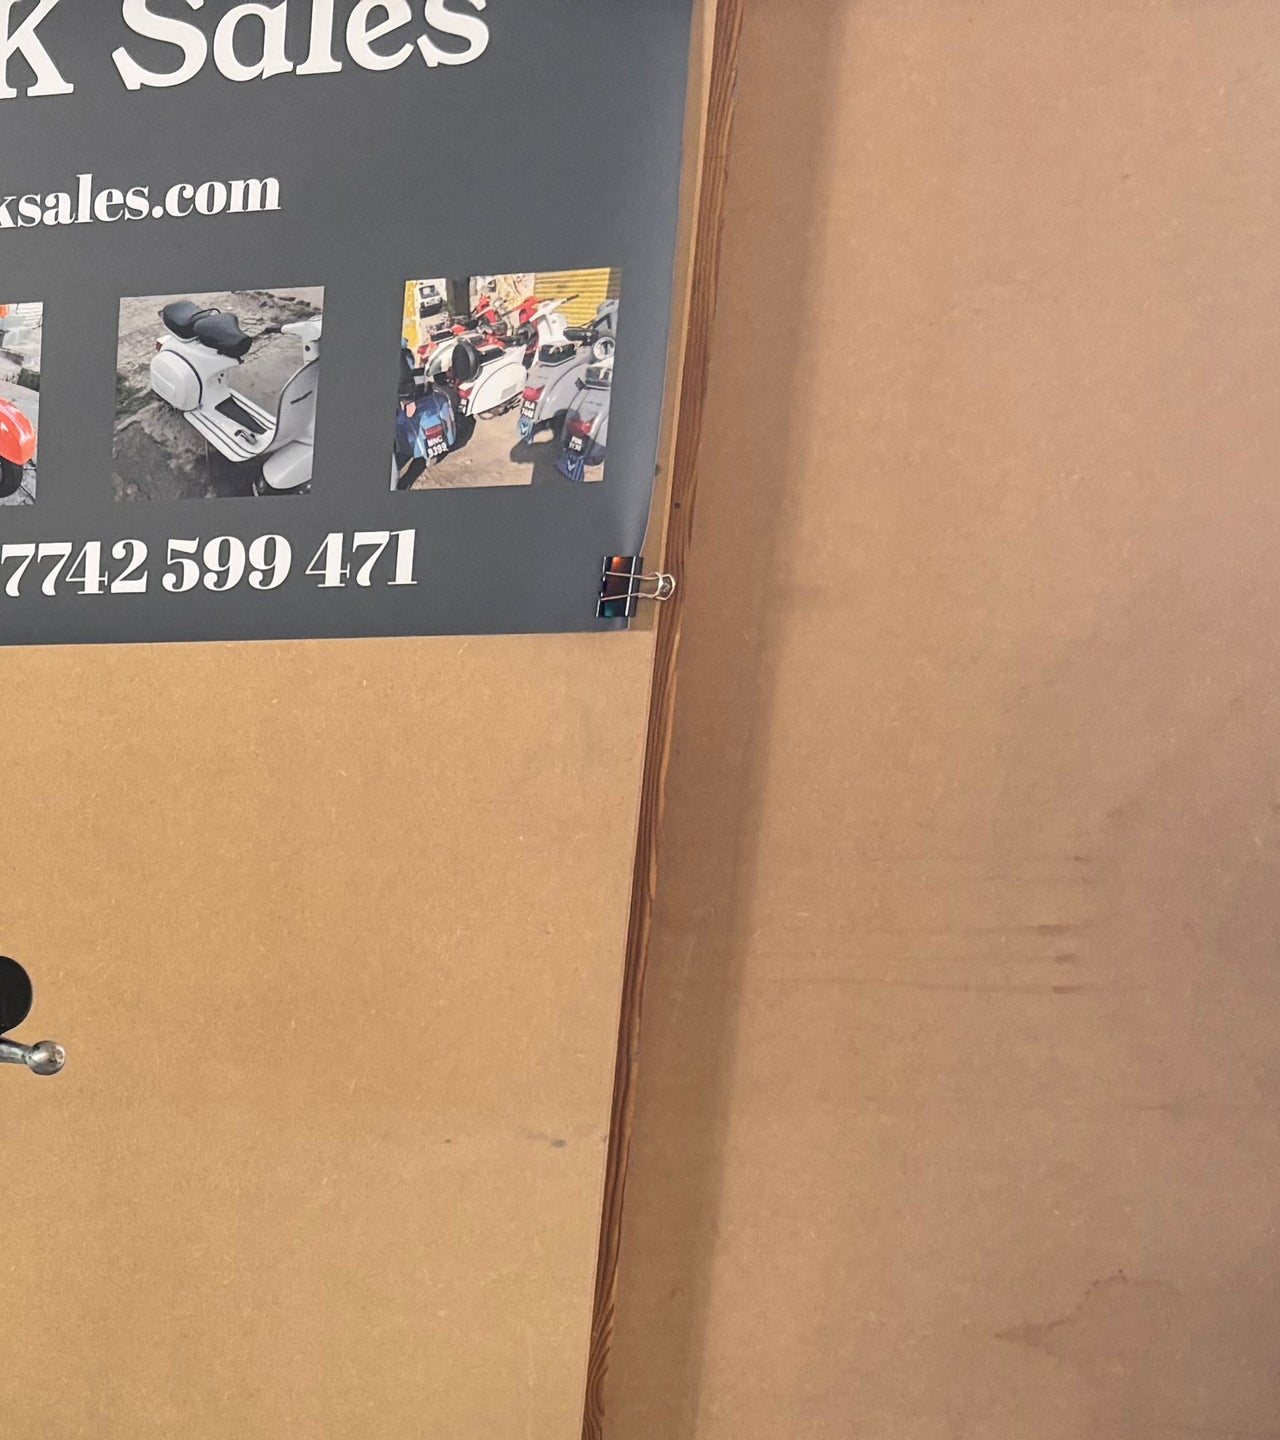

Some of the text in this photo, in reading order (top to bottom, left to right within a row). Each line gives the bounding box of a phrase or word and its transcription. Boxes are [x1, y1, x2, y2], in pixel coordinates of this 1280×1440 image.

[111, 0, 490, 91] Sales
[161, 534, 292, 593] 599
[305, 528, 418, 588] 471
